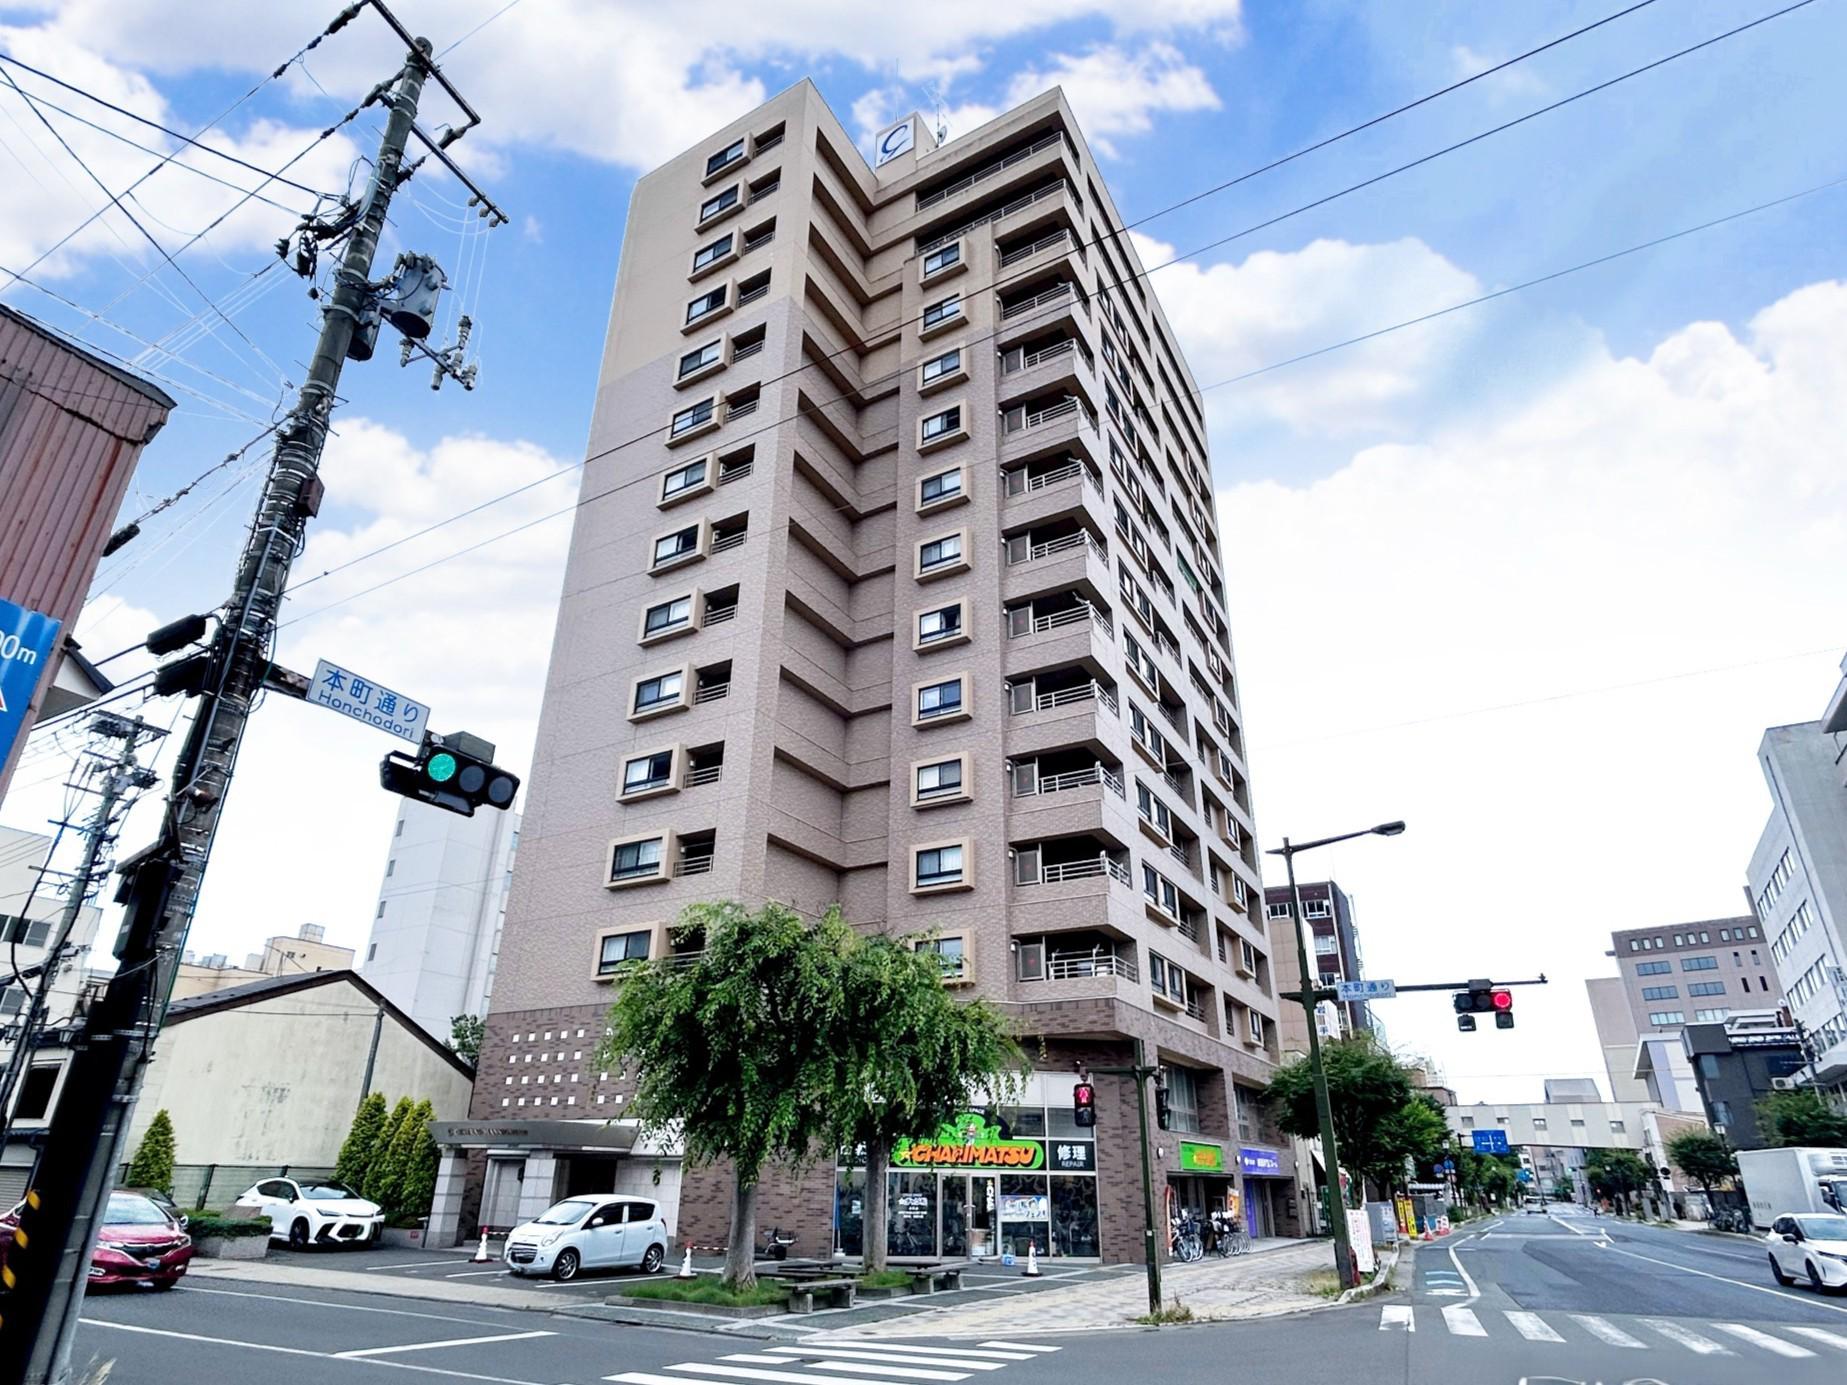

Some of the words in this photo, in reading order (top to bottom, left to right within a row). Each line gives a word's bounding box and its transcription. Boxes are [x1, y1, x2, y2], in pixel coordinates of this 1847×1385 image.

[0, 630, 37, 665] 0m
[322, 669, 420, 723] 本町通り
[318, 690, 415, 739] Honchodori
[911, 1144, 1035, 1165] CHARIMATSU
[1057, 1144, 1087, 1161] 修理
[1061, 1160, 1085, 1168] REPAIR
